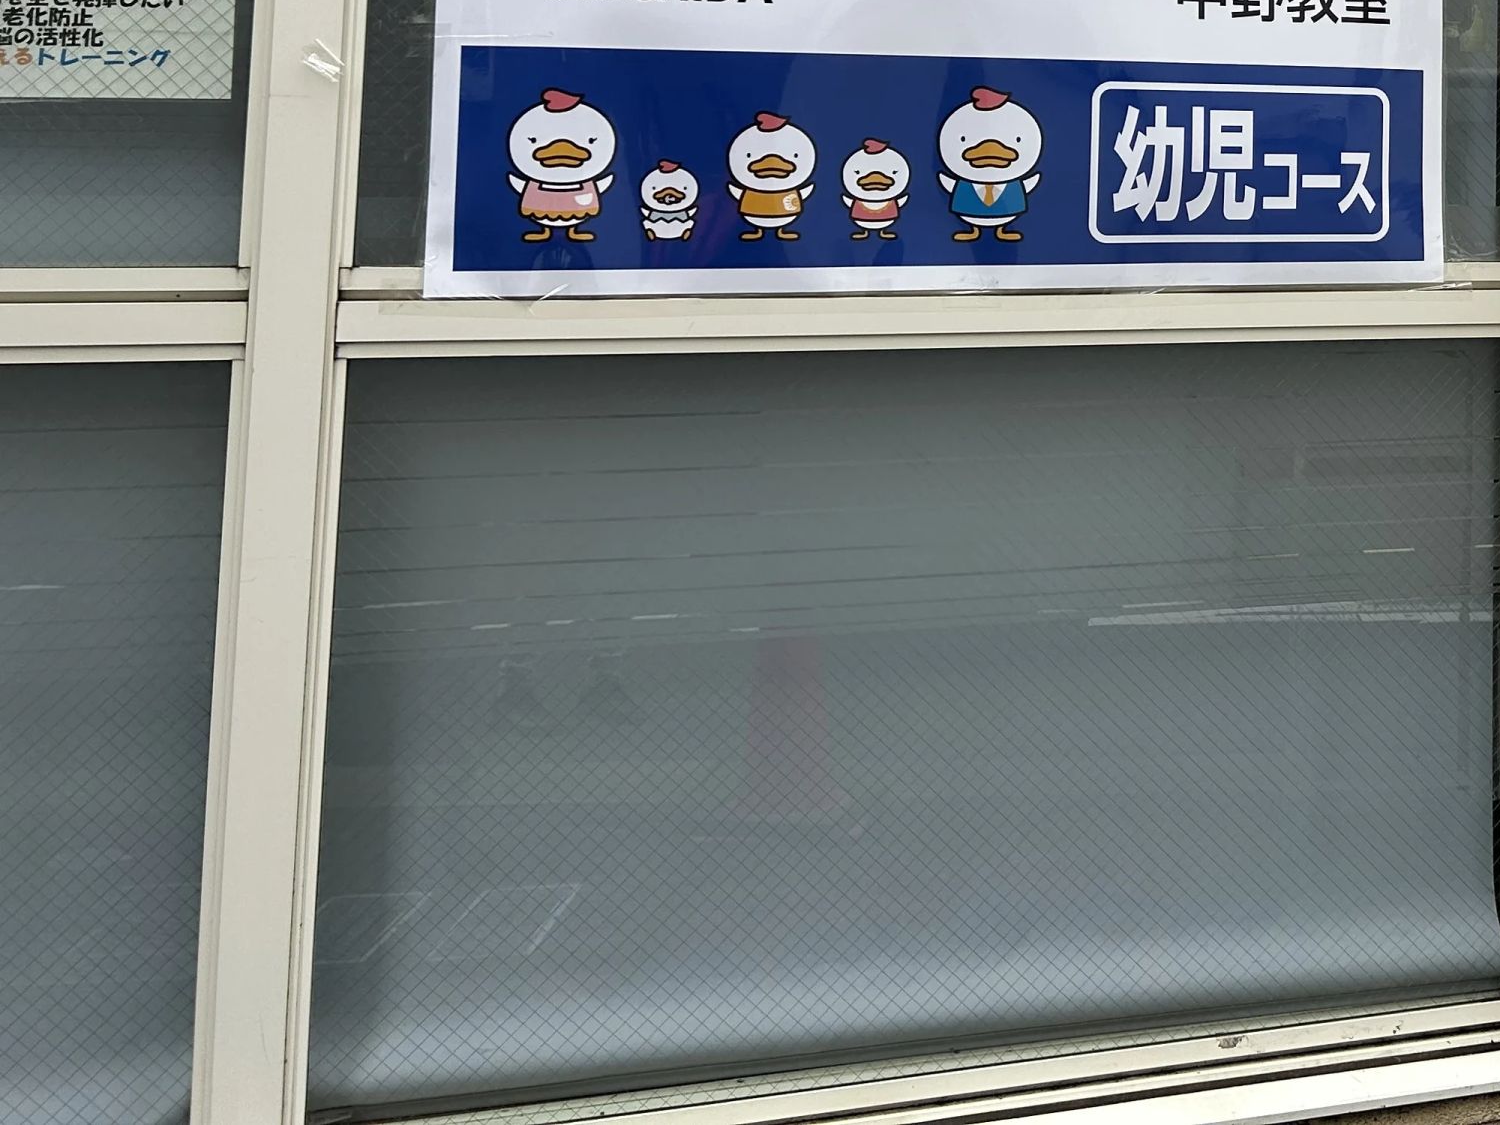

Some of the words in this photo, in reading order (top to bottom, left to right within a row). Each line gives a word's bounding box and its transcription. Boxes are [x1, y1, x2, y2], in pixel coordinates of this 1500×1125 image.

[3, 8, 93, 26] 老化防止
[1113, 105, 1376, 222] 幼児コース
